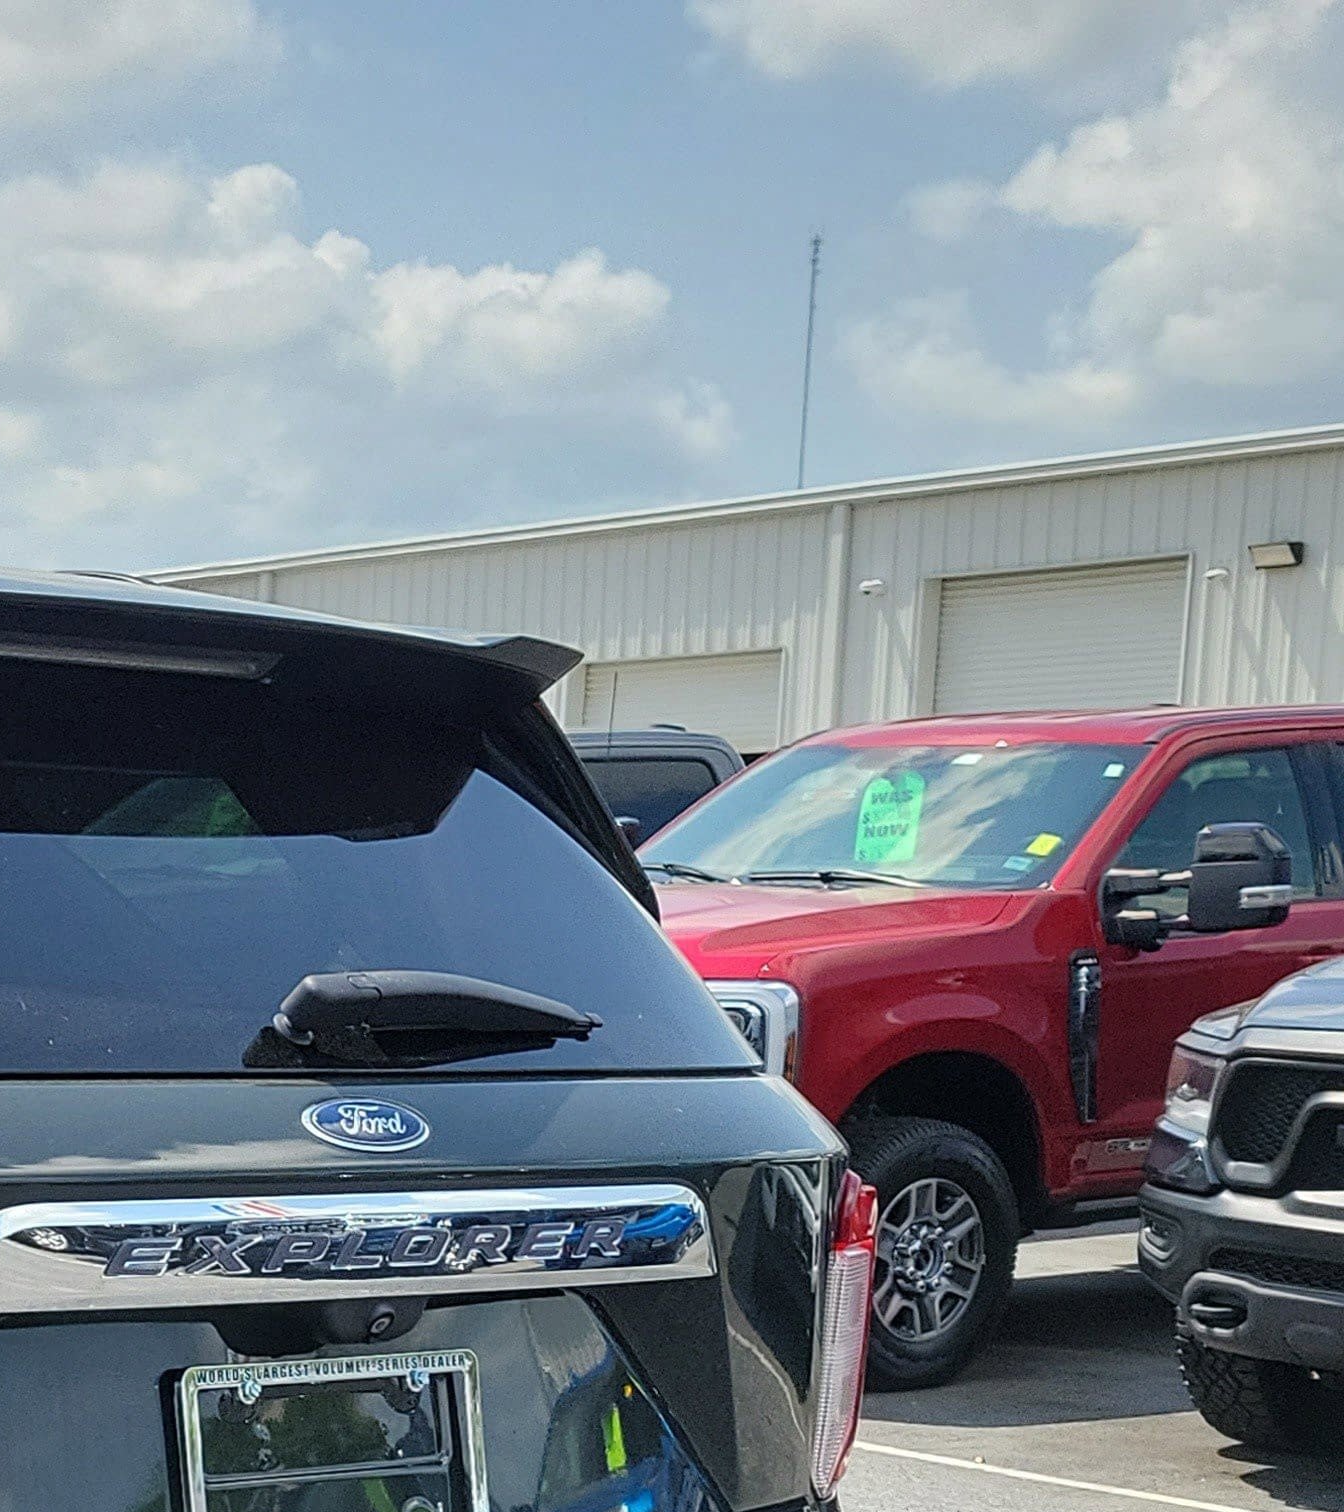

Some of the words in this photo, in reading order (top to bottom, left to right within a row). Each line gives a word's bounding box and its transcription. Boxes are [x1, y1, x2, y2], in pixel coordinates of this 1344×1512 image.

[337, 1104, 407, 1135] Ford
[102, 1219, 627, 1278] EXPLORER
[195, 1366, 251, 1384] WORLD'S
[256, 1363, 310, 1380] LARGEST
[314, 1359, 361, 1375] VOLUME
[422, 1353, 465, 1369] DEALER
